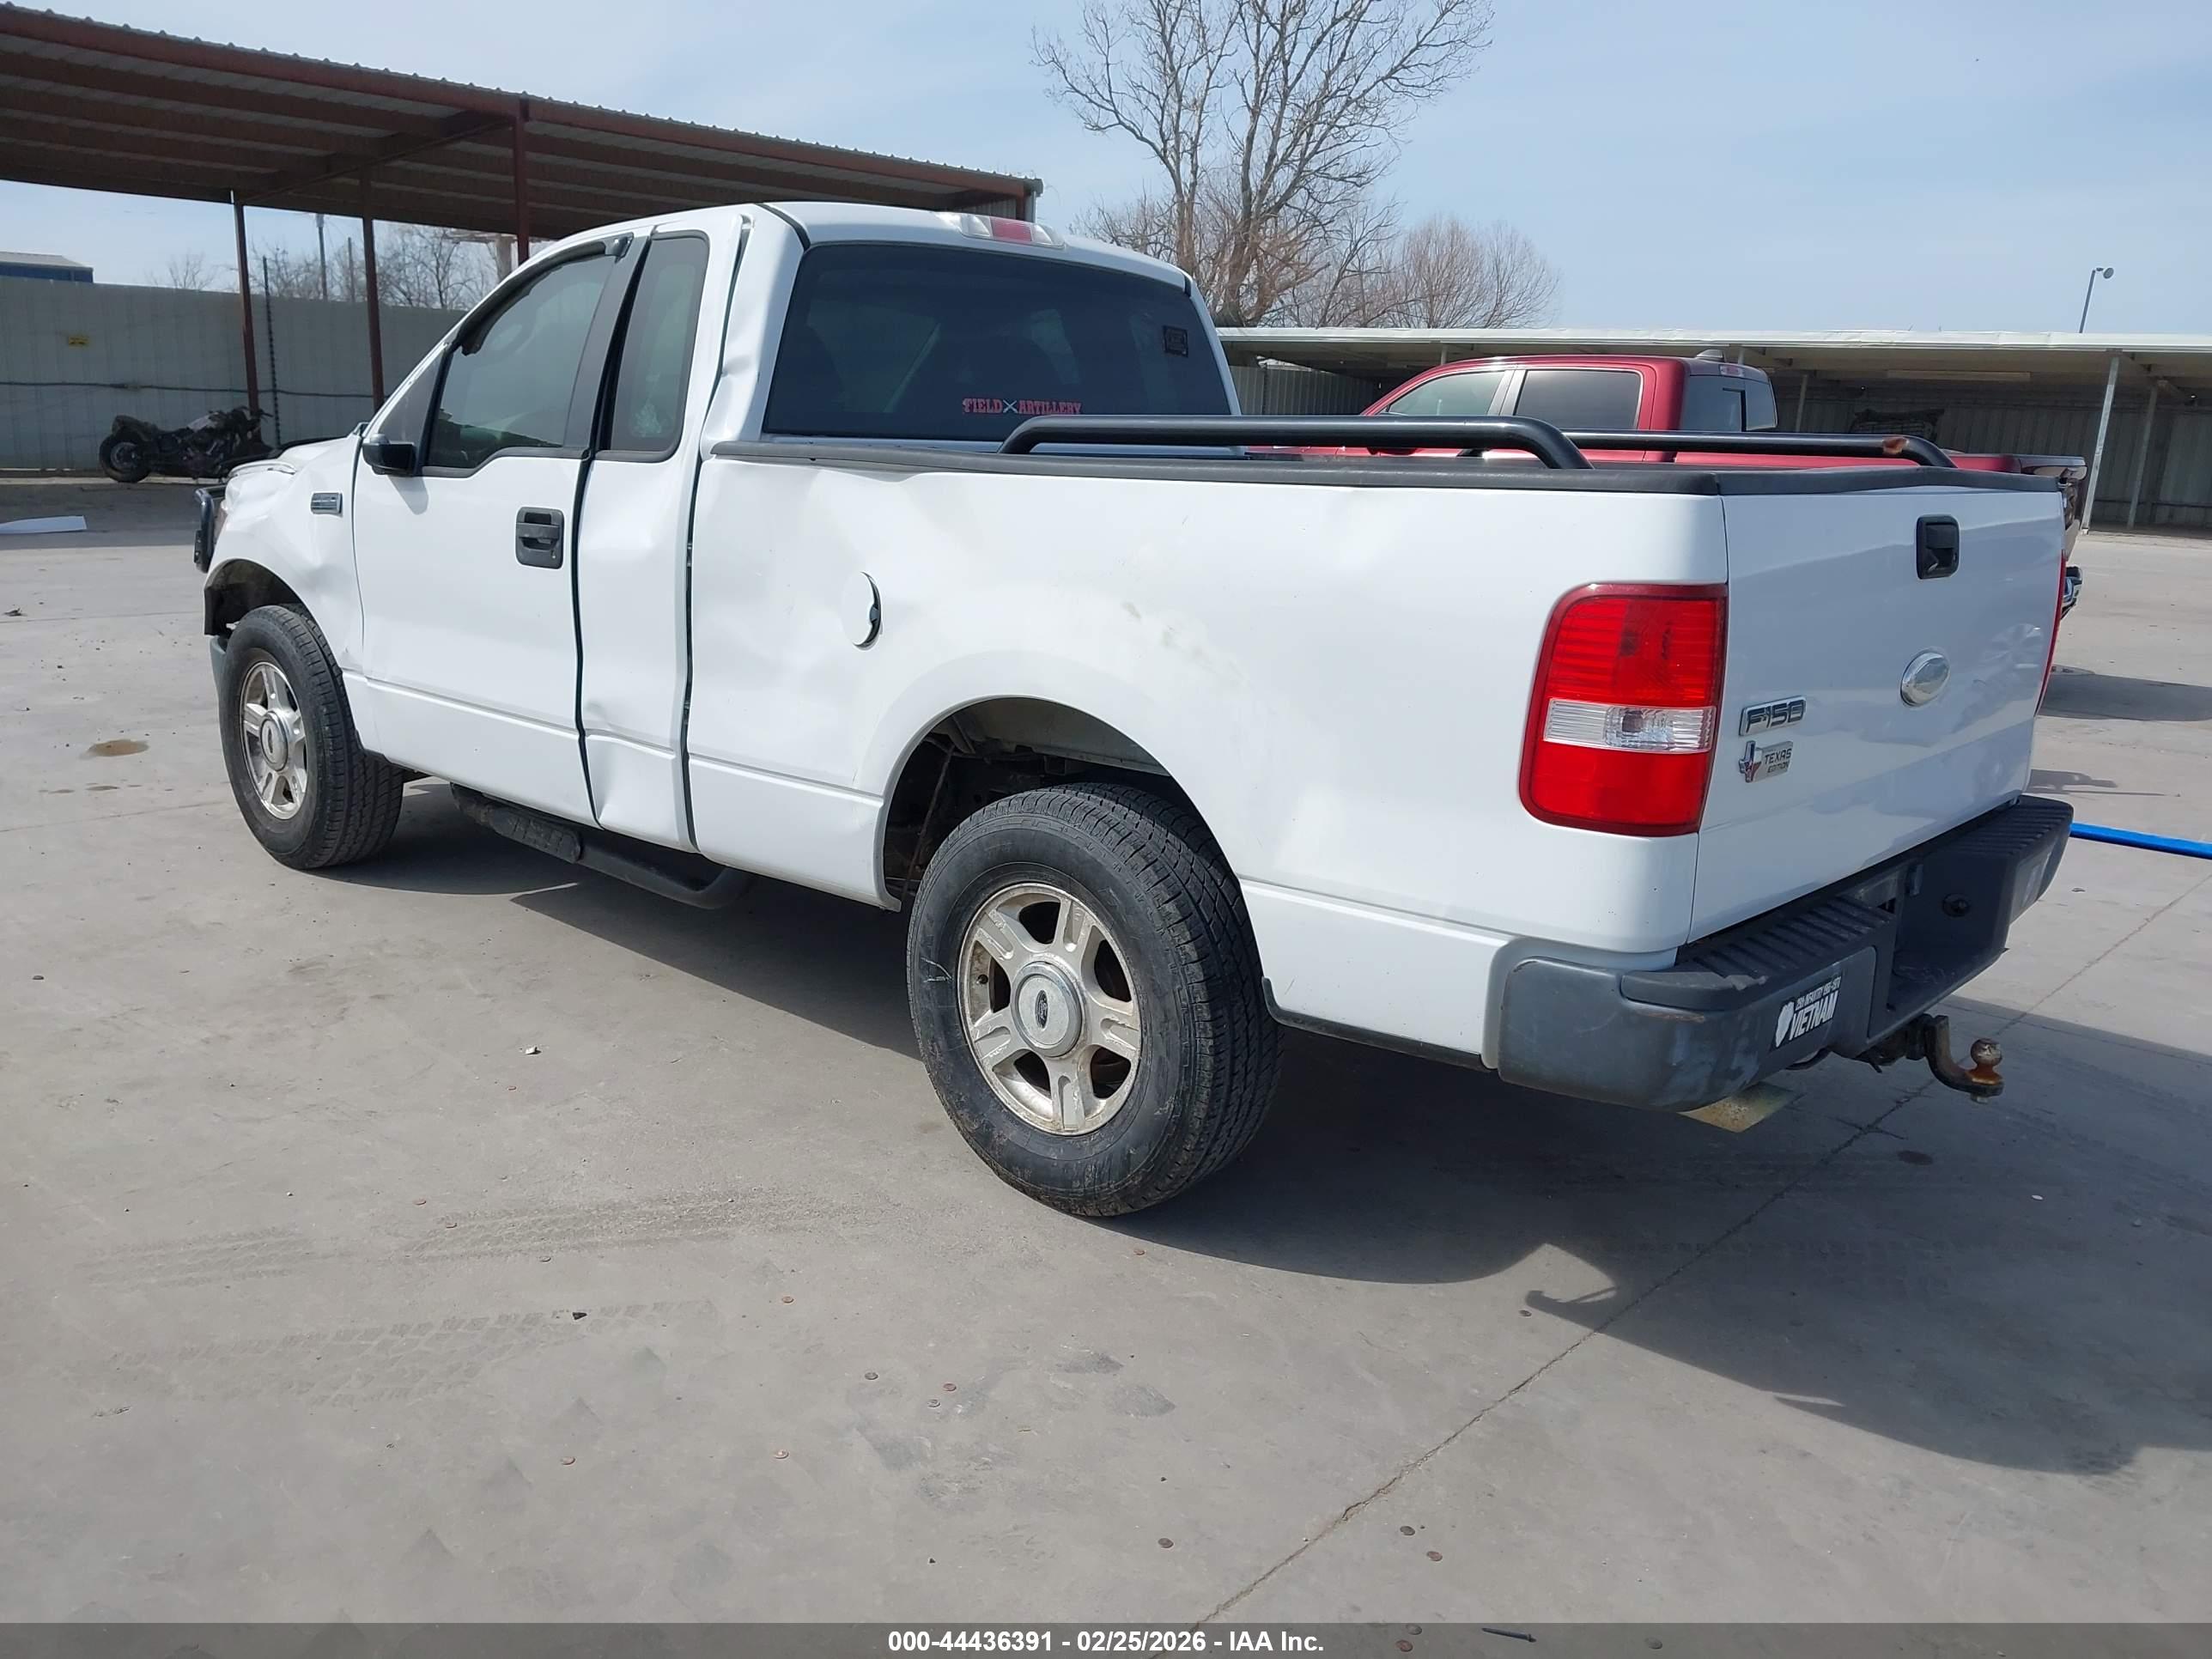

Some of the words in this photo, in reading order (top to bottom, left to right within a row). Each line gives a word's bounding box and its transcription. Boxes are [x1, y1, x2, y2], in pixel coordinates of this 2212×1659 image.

[963, 398, 1003, 413] FIELD
[1018, 400, 1081, 415] ARTILLERY
[1765, 748, 1792, 764] TEXAS
[1789, 990, 1838, 1041] VIETNAM
